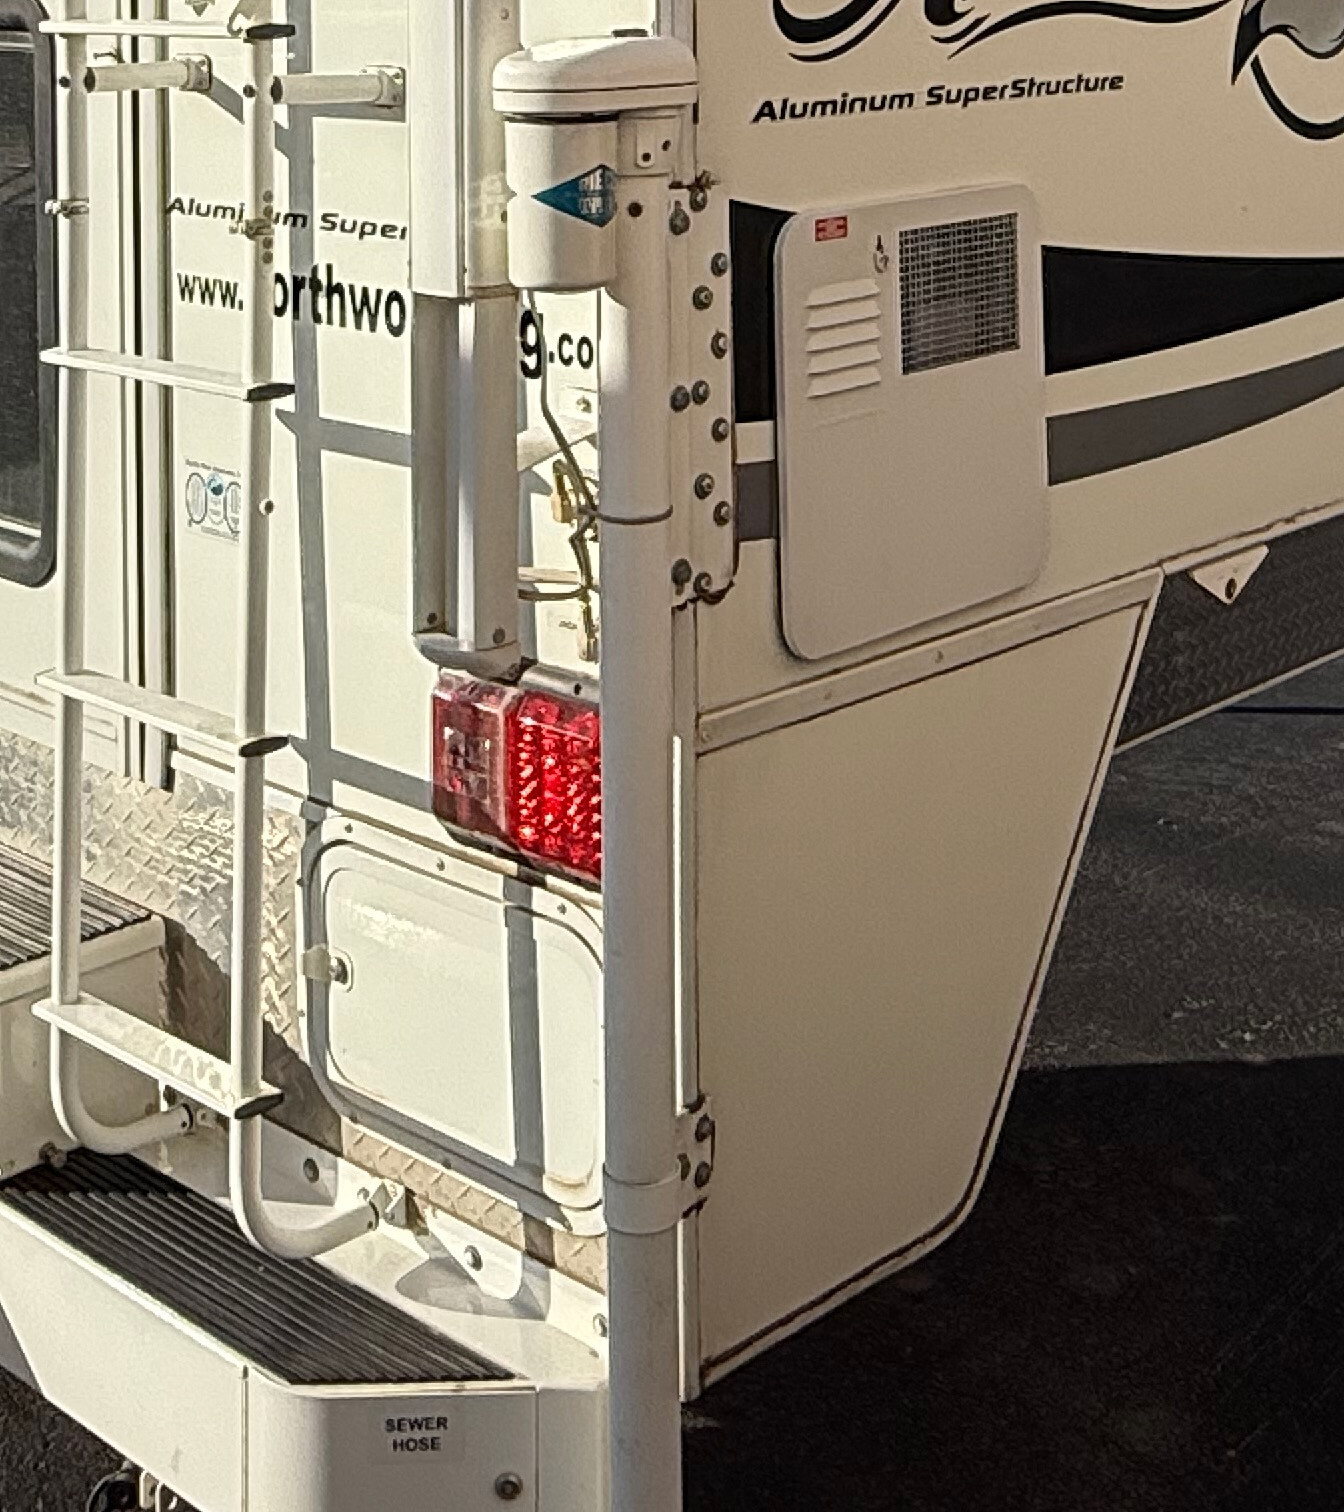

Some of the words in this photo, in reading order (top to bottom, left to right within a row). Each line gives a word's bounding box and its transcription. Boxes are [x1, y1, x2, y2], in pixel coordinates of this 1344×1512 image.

[750, 92, 915, 124] Aluminum
[925, 73, 1125, 110] SuperStructure
[165, 196, 308, 229] Alumium
[385, 1416, 448, 1434] SEWER
[392, 1436, 442, 1452] HOSE
